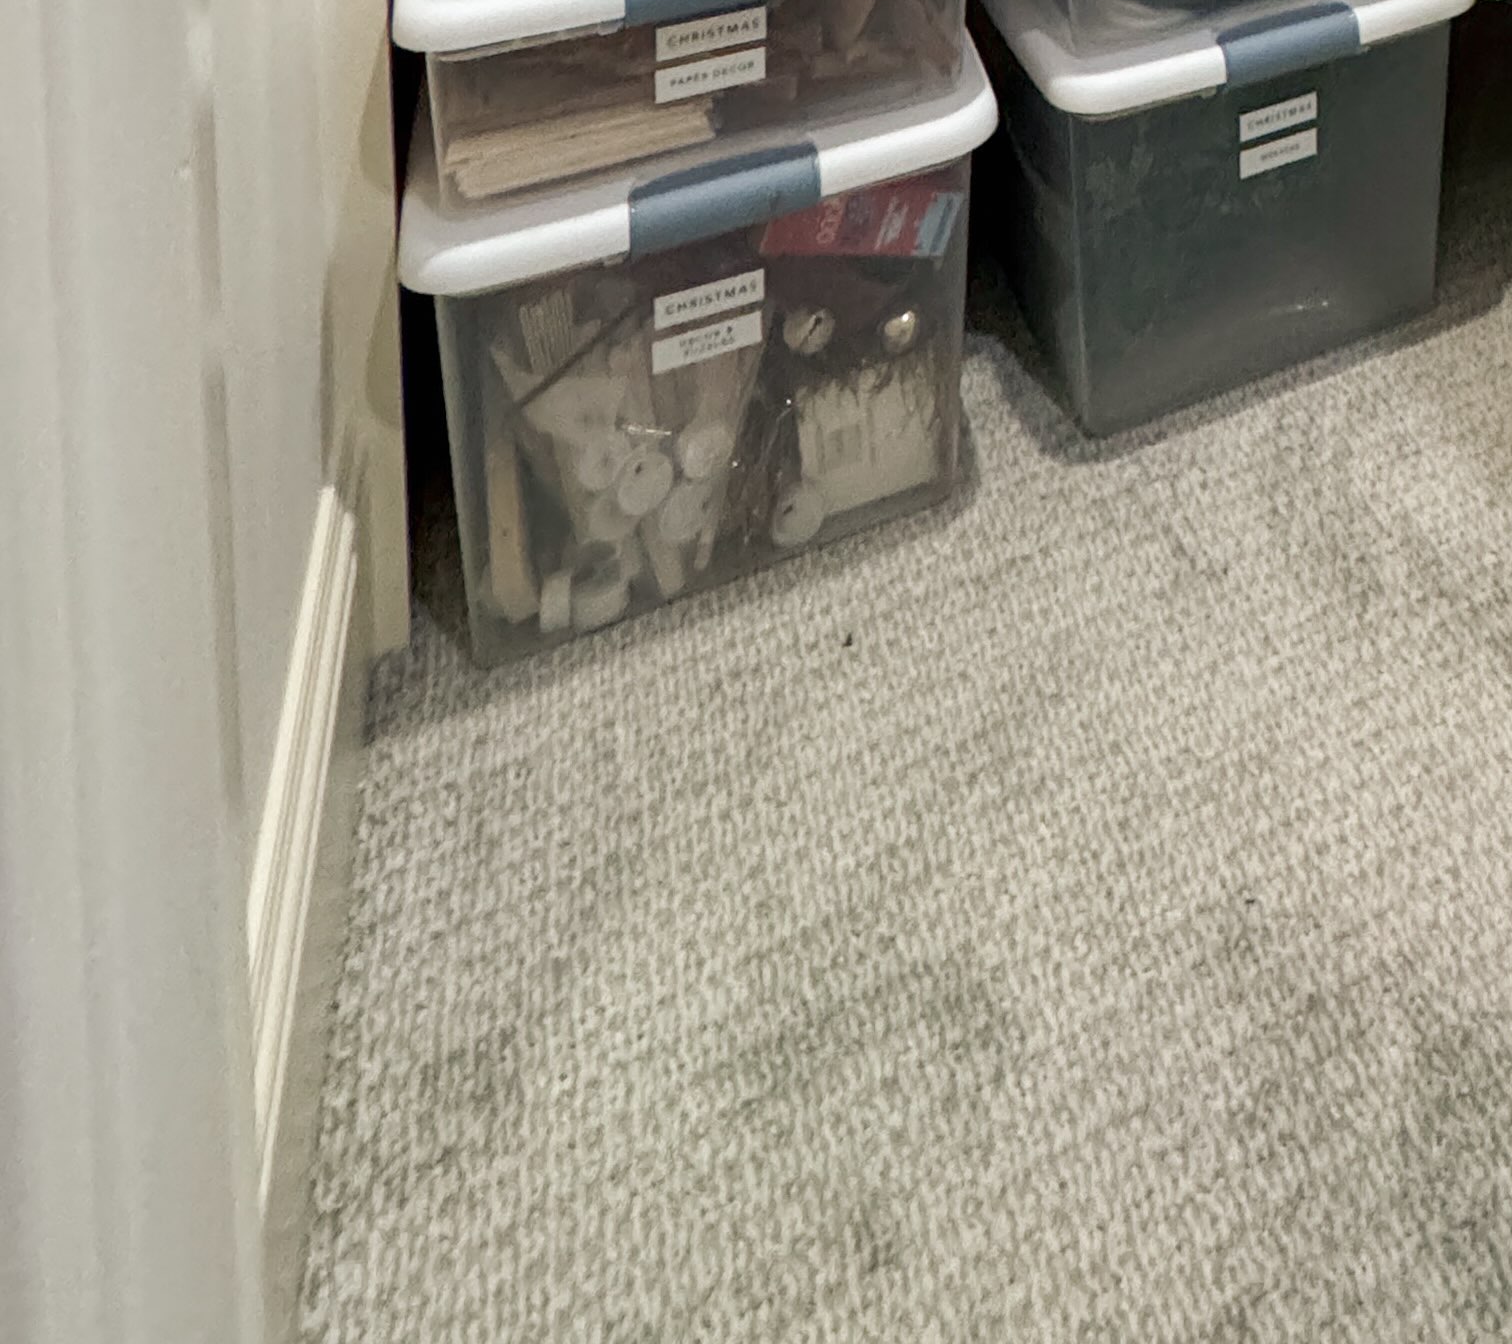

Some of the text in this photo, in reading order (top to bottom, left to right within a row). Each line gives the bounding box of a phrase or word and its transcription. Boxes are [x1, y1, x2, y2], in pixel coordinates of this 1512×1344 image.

[666, 18, 761, 50] CHRISTMAS
[669, 59, 755, 88] PAPER DECOR
[1247, 101, 1312, 132] CHRISTMAS
[663, 279, 758, 316] CHRISTMAS
